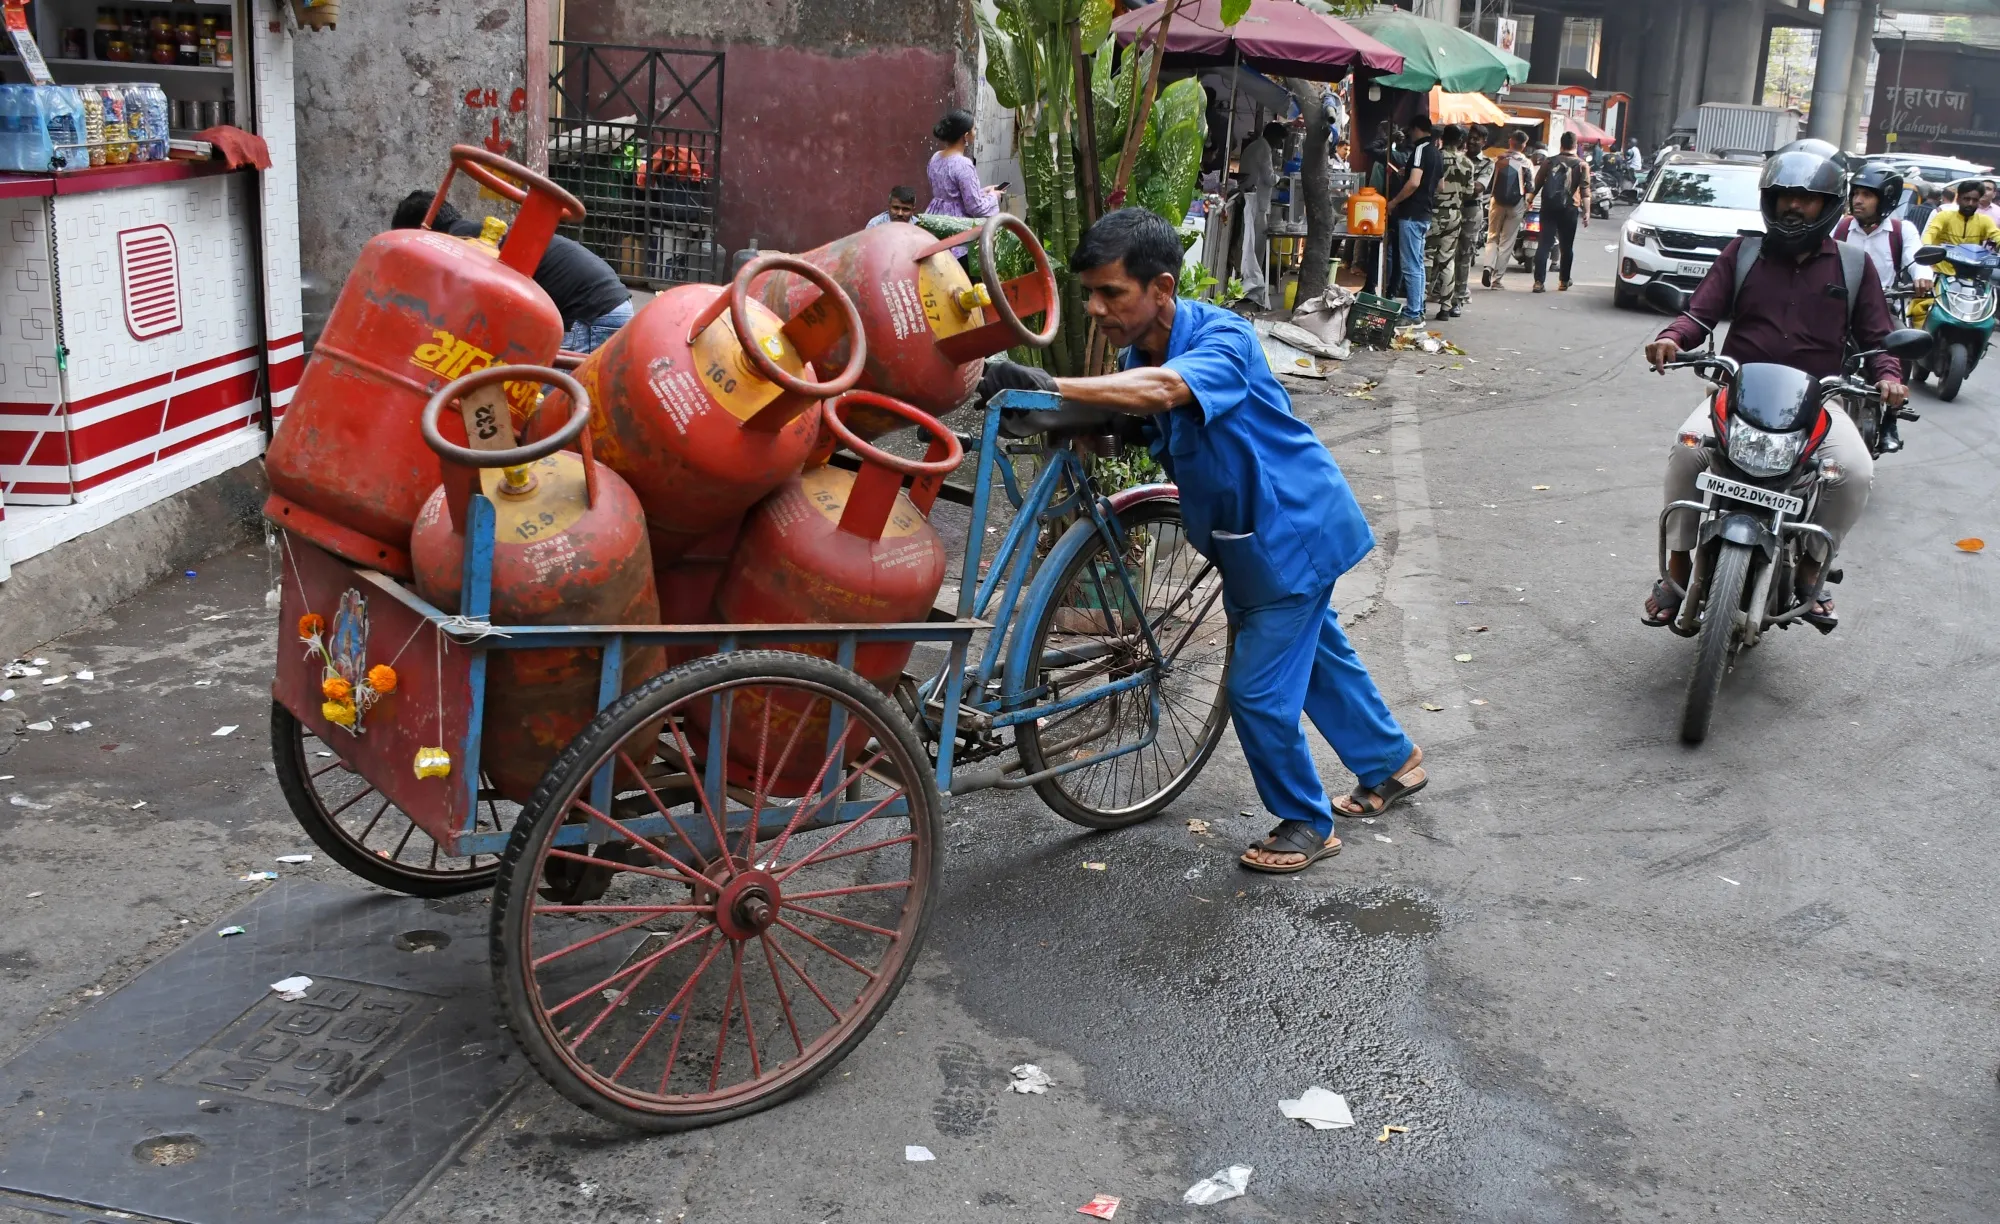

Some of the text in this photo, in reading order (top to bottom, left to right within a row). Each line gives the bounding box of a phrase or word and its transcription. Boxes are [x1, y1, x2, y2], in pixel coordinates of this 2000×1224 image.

[1886, 86, 1969, 111] महाराजा
[1880, 110, 1948, 142] Maharaja
[885, 296, 904, 341] DELIVERY
[923, 293, 940, 322] 15.7
[705, 362, 737, 394] 16.0
